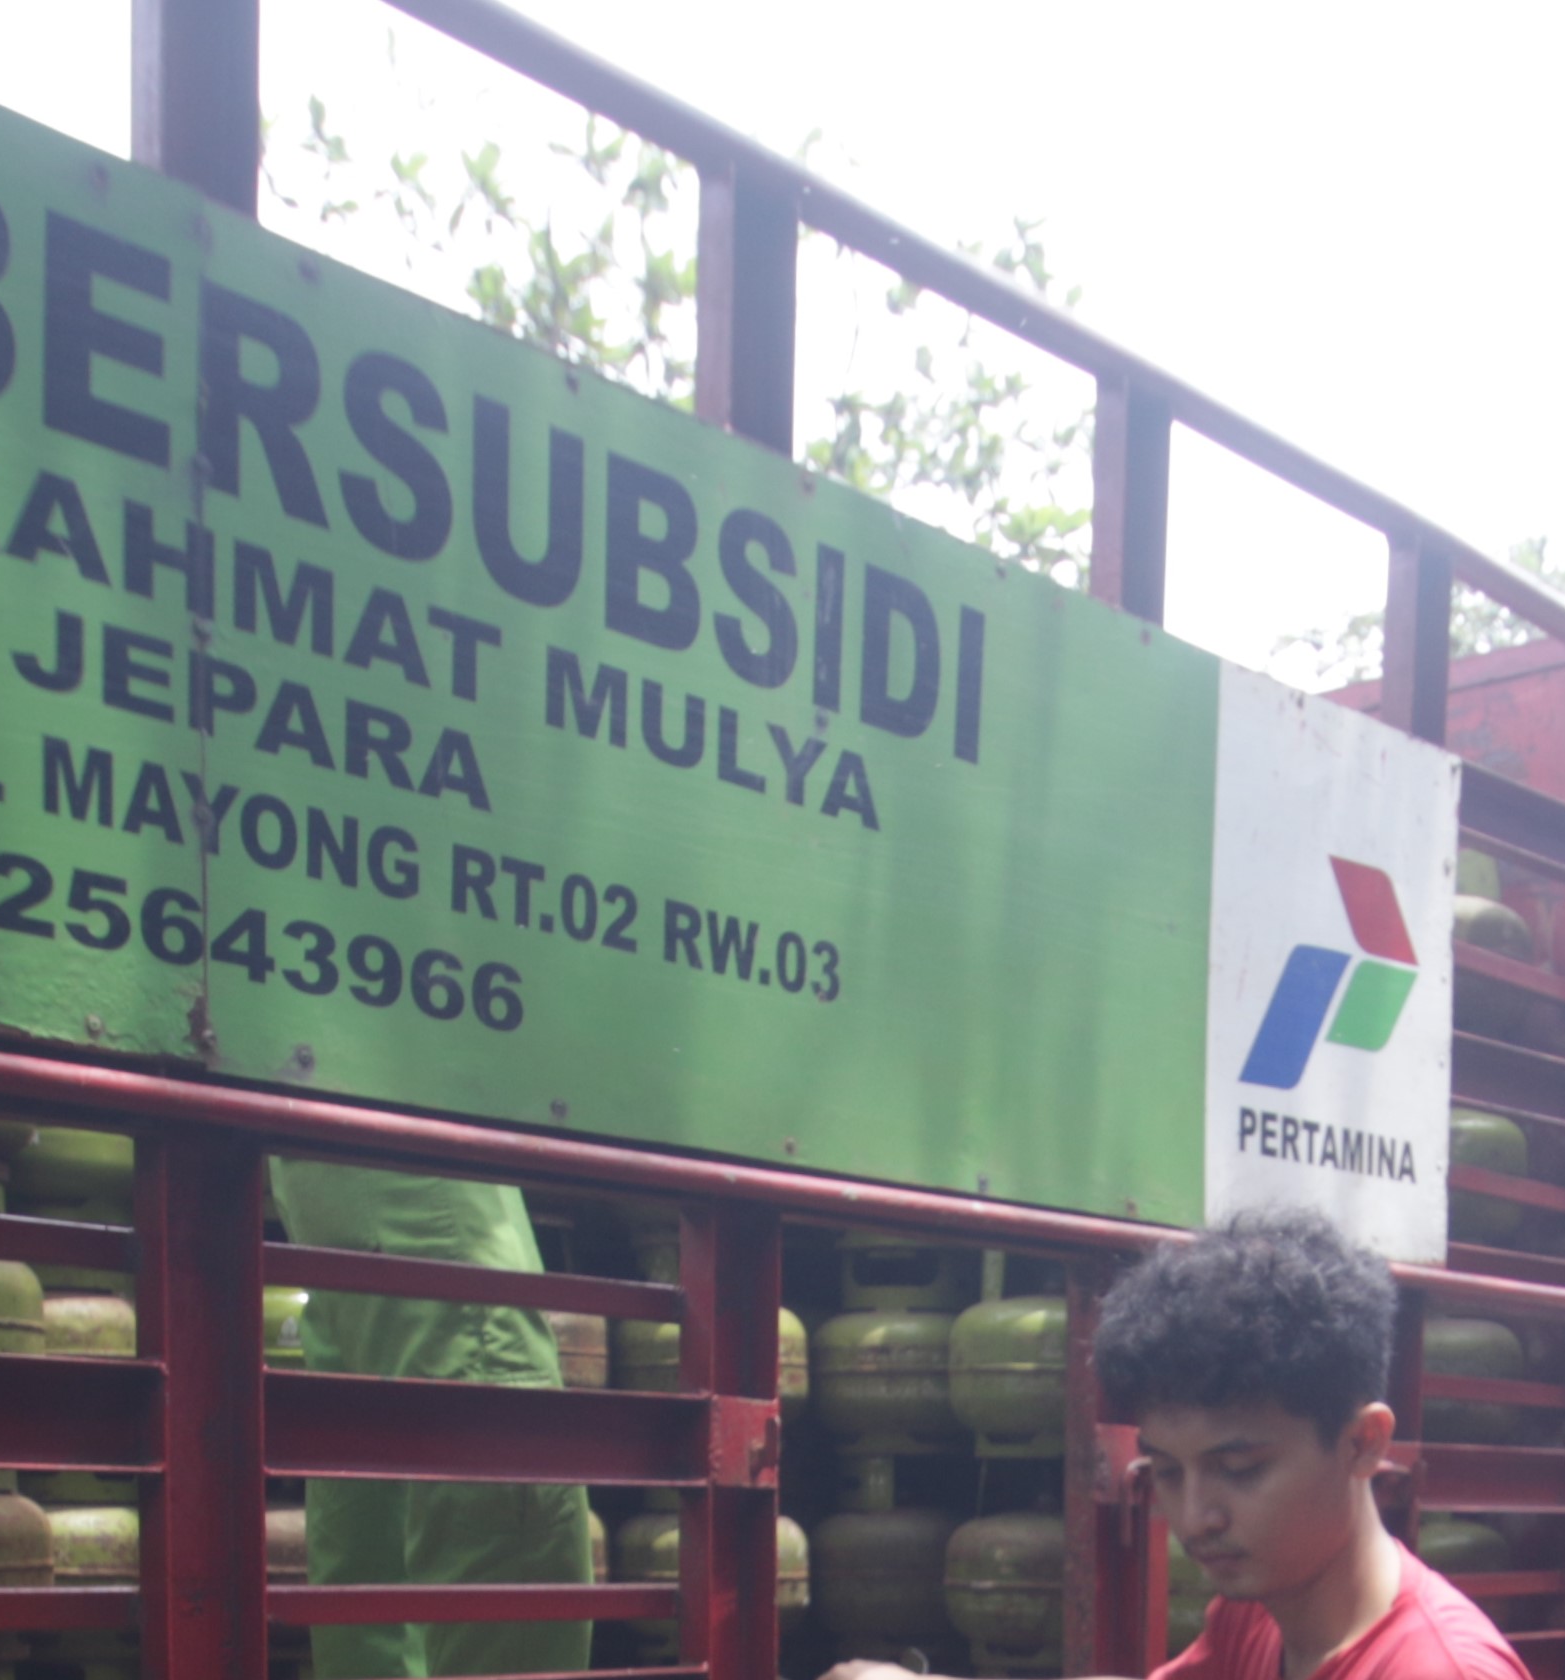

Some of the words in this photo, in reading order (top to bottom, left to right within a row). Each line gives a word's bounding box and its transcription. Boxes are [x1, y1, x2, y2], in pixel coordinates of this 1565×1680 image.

[13, 609, 493, 813] JEPARA
[545, 645, 883, 832] MULYA
[43, 735, 421, 901] MAYONG
[451, 843, 639, 954] RT.02
[663, 899, 841, 1002] RW.03
[1238, 1107, 1417, 1185] PERTAMINA
